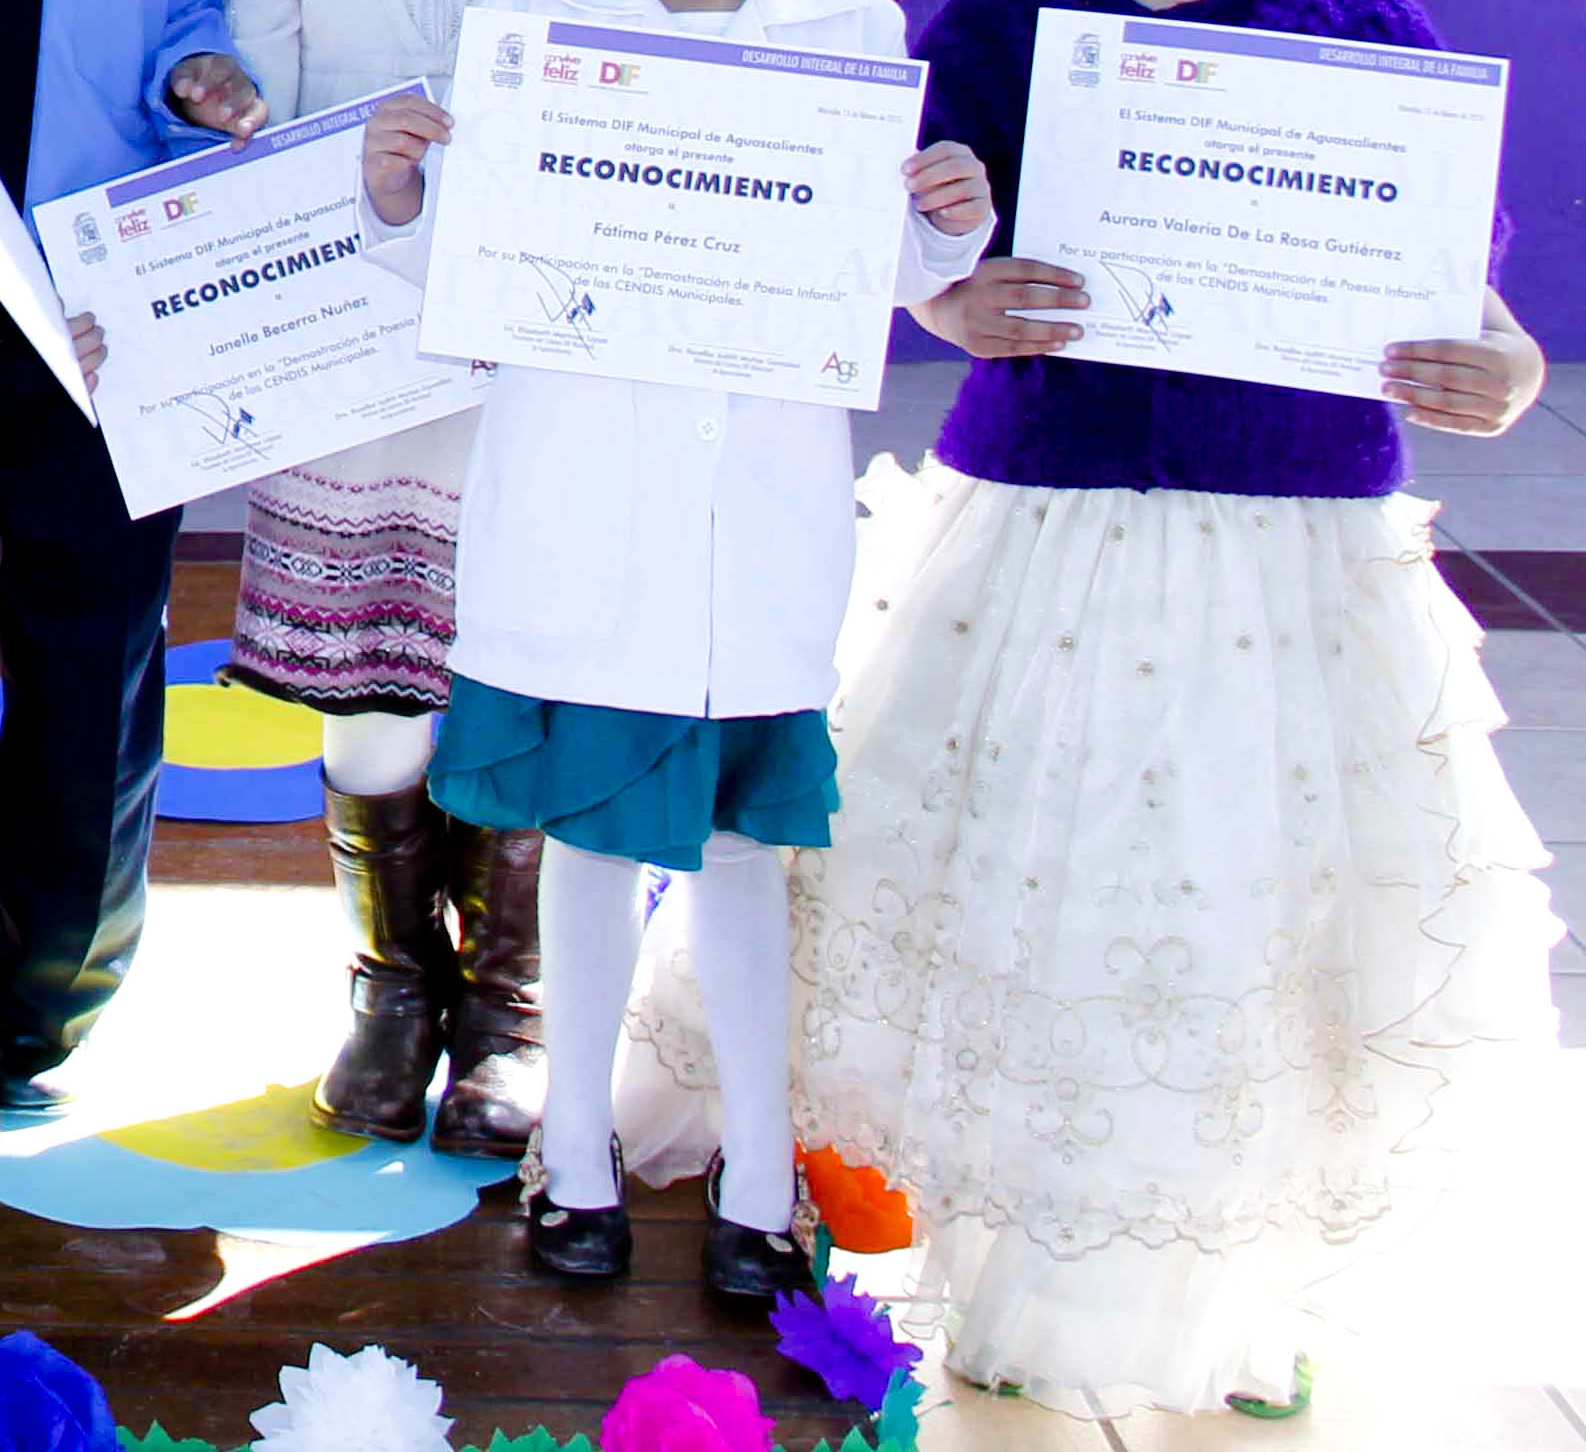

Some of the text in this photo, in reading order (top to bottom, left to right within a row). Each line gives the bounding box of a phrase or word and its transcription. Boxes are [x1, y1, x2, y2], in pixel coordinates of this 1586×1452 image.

[543, 61, 578, 81] feliz
[598, 60, 641, 87] DIF
[741, 49, 907, 81] DESARROLLO INTEGRAL DE LA FAMILIA
[1119, 59, 1156, 79] feliz
[1175, 58, 1218, 84] DIF
[540, 109, 824, 156] El Sistema DIF Municipal de Aguascalientes
[1118, 107, 1406, 153] El Sistema DIF Municipal de Aguascalientes
[624, 142, 734, 164] otorga el presente
[538, 152, 813, 205] RECONOCIMIENTO
[1118, 149, 1398, 203] RECONOCIMIENTO
[161, 191, 198, 222] DIF
[117, 218, 151, 238] feliz
[593, 221, 741, 253] Fátima Pérez Cruz
[1097, 209, 1402, 261] Aurora Valeria De La Rosa Gutiérrez
[135, 263, 147, 276] El
[147, 251, 193, 272] Sistema
[194, 241, 215, 256] DIF
[216, 220, 274, 249] Municipal
[275, 217, 291, 229] de
[150, 232, 361, 319] RECONOCIMIEN
[477, 245, 847, 302] Por su participación en la "Demostración de Poesía Infantil"
[571, 275, 744, 306] de los CENDIS Municipales.
[209, 331, 259, 356] Janelle
[261, 313, 318, 338] Becerra
[820, 351, 859, 384] Ags
